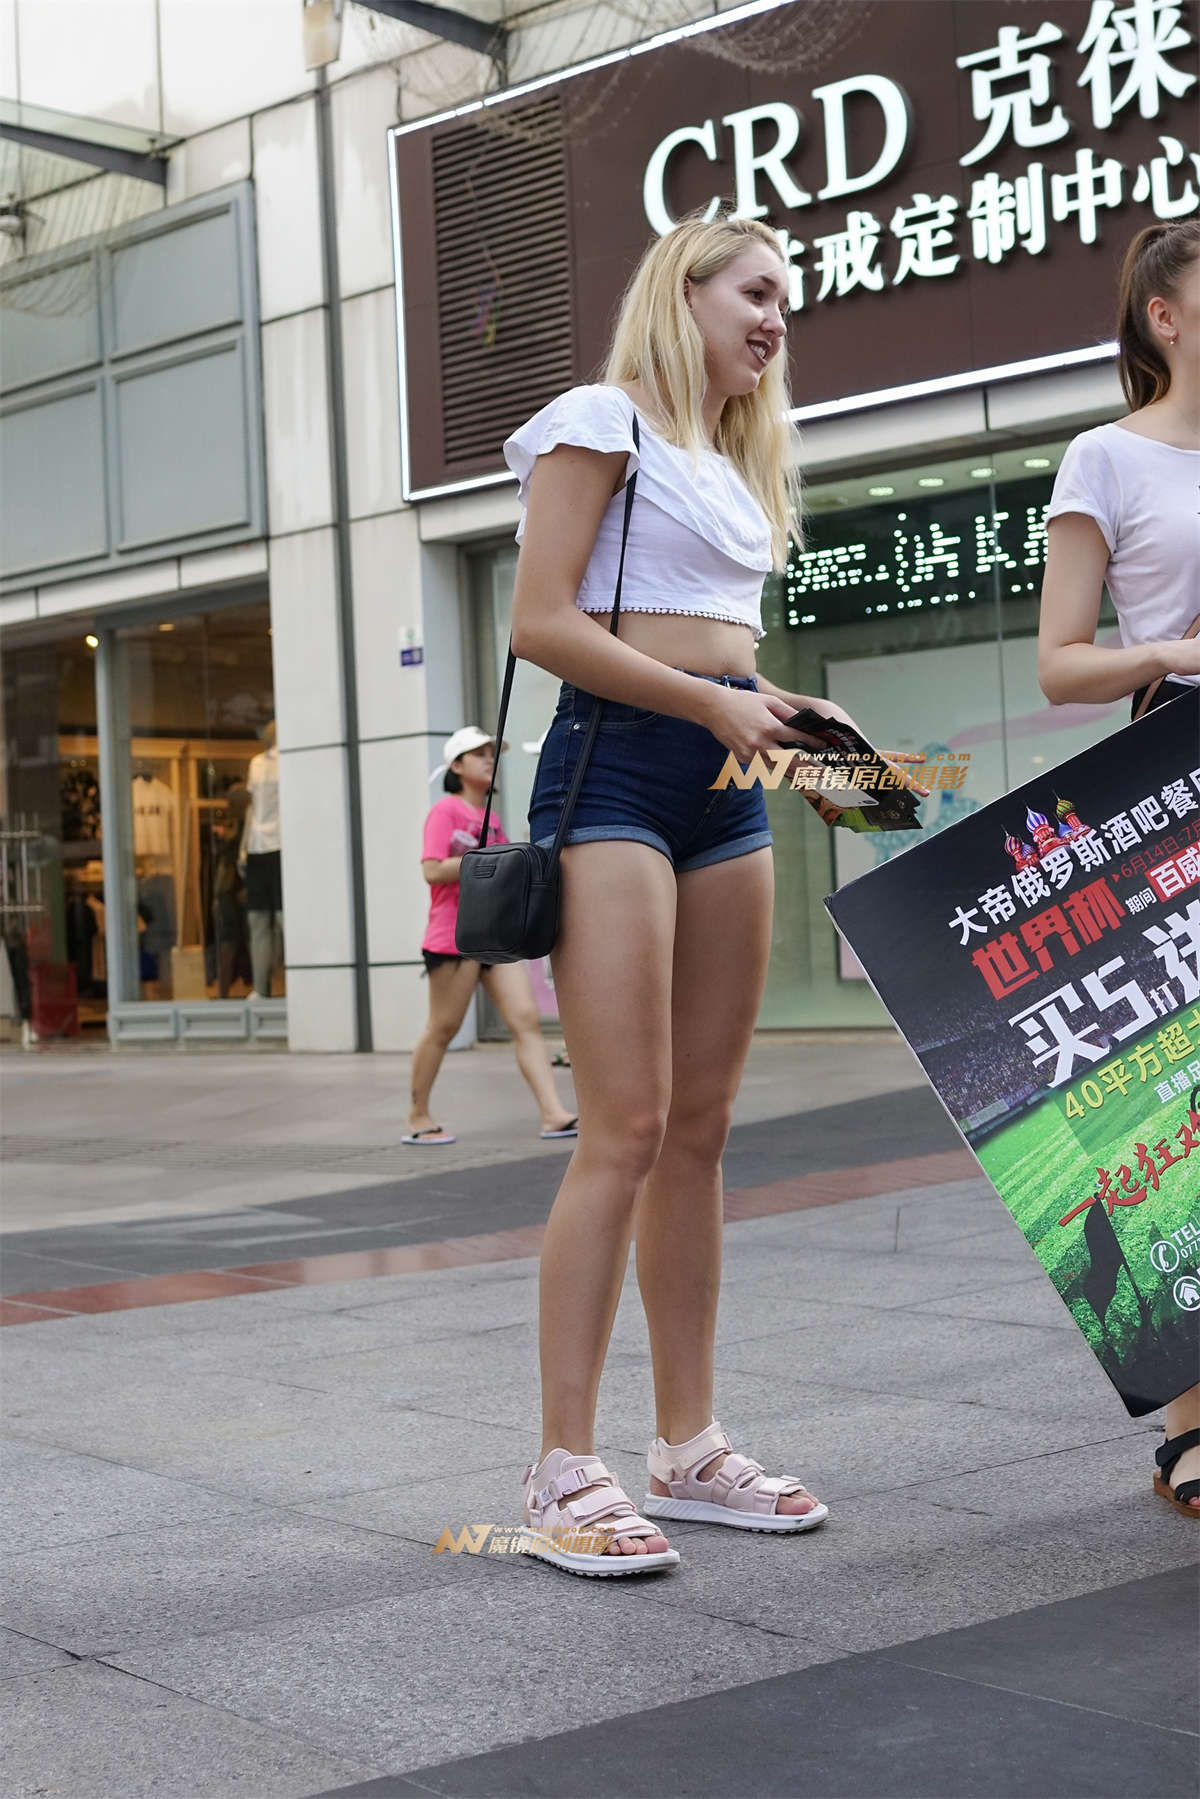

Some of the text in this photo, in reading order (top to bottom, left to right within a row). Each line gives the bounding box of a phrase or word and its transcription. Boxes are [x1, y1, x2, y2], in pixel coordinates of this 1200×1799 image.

[643, 74, 909, 237] CRD
[971, 877, 1126, 1000] 世界杯
[1125, 887, 1157, 915] 期间
